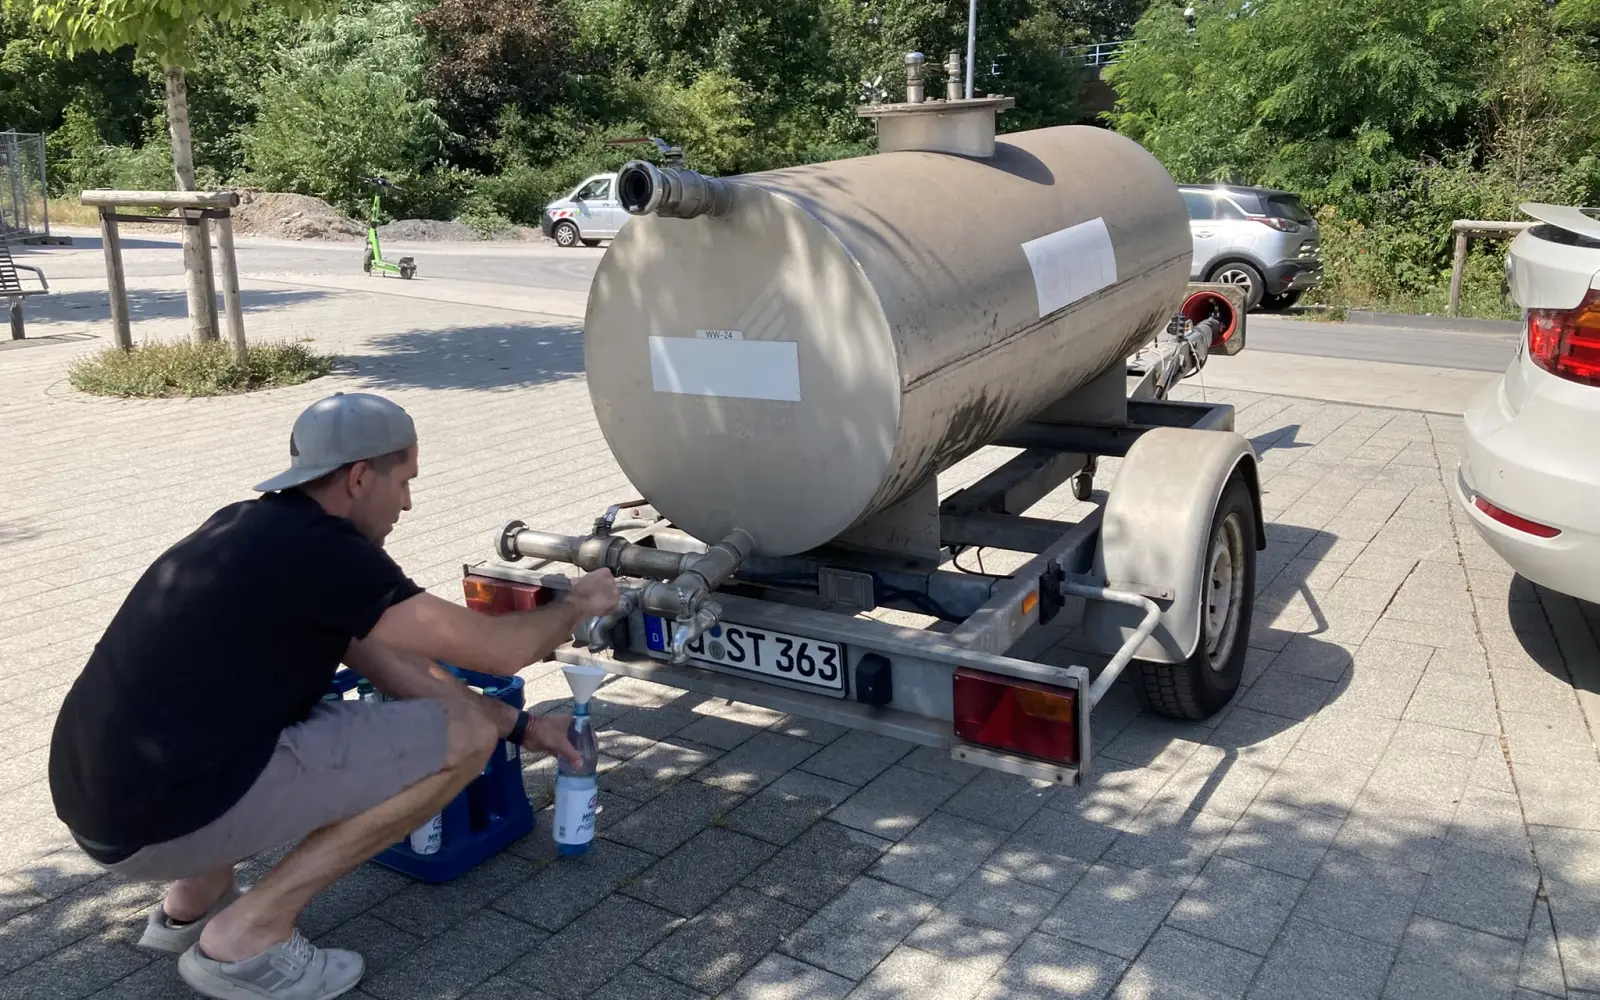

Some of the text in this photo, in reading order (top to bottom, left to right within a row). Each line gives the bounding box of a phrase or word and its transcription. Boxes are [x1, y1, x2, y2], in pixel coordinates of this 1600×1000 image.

[705, 330, 733, 339] WW-24
[726, 628, 766, 666] ST
[775, 636, 838, 682] 363
